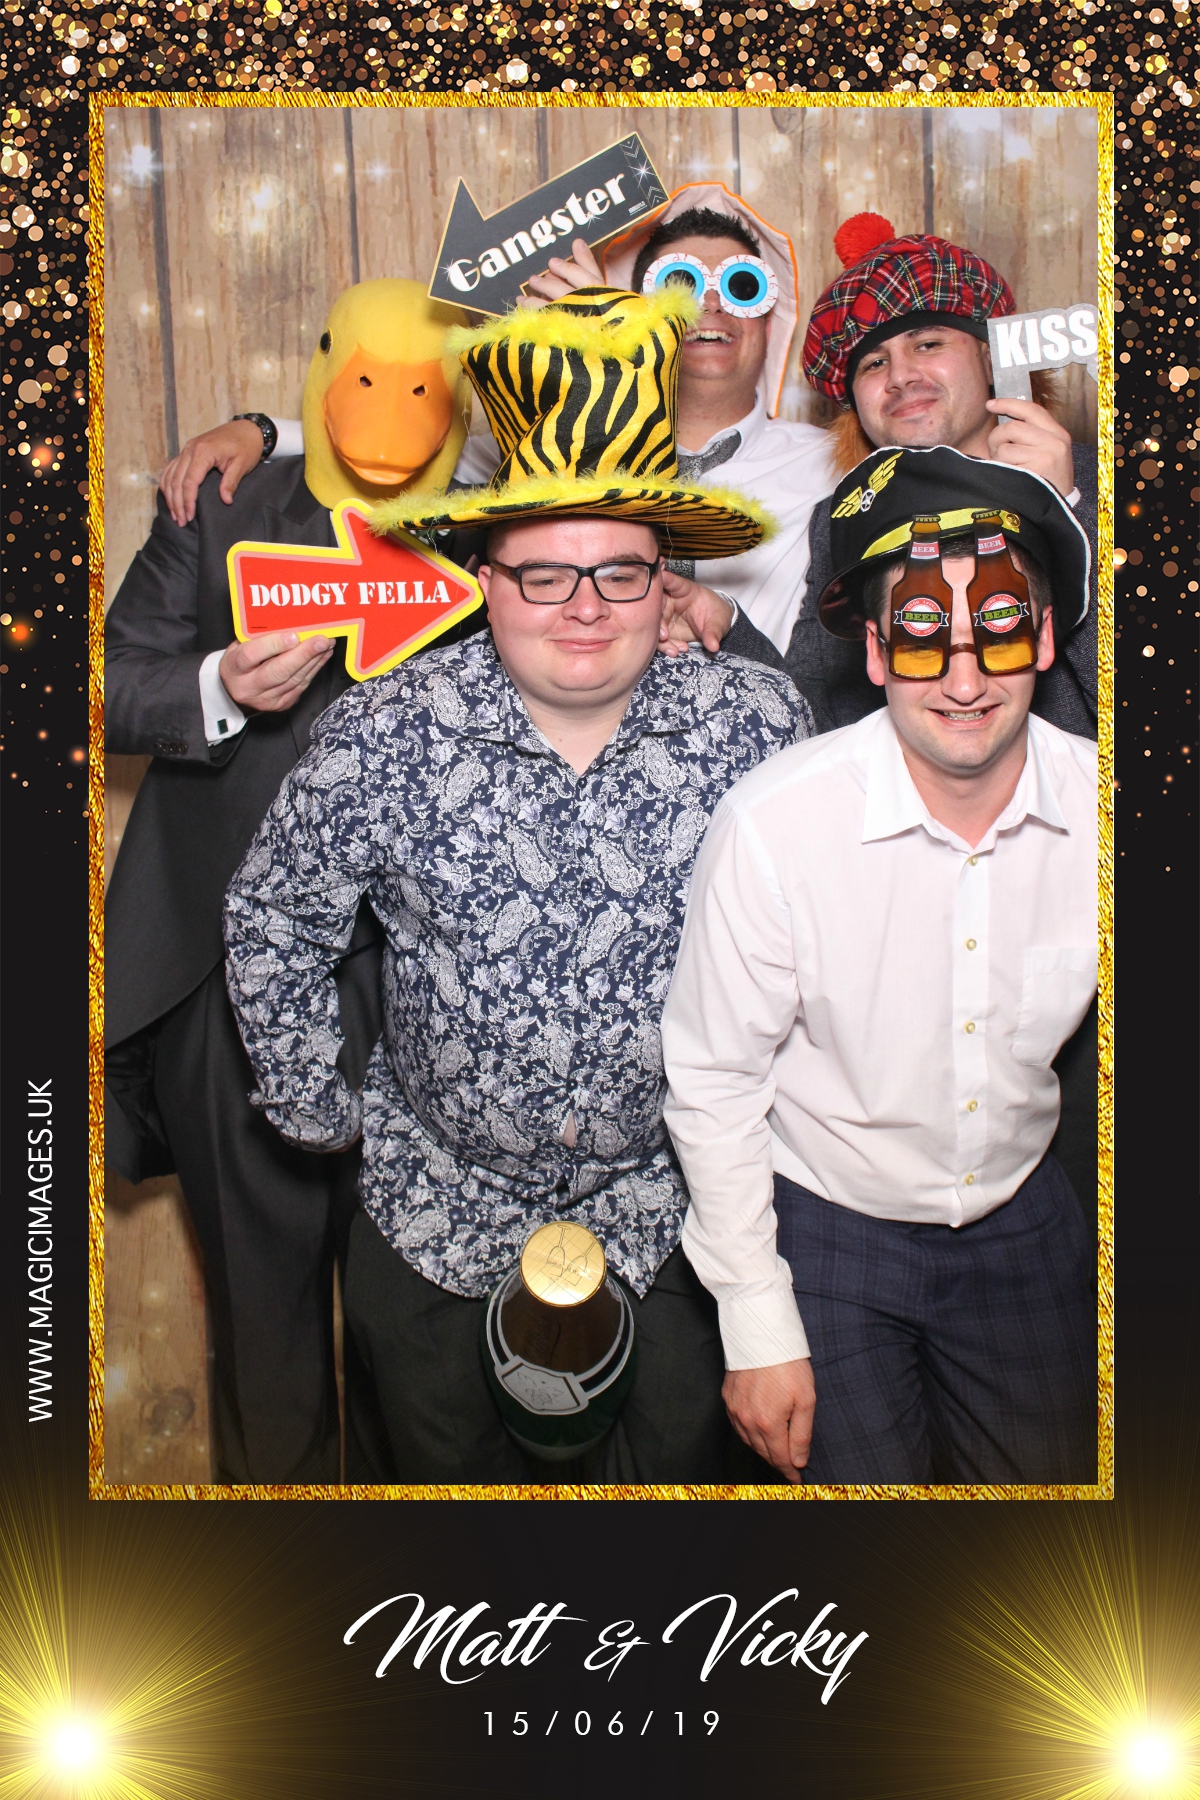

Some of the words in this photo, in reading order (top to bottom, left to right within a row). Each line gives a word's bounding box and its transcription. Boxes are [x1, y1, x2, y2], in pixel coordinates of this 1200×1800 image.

[449, 173, 626, 292] Gangster
[995, 310, 1098, 368] KISS
[978, 540, 1002, 550] BEER
[249, 582, 349, 607] DODGY
[357, 580, 452, 605] FELLA
[904, 612, 939, 622] BEER
[984, 606, 1019, 621] BEER
